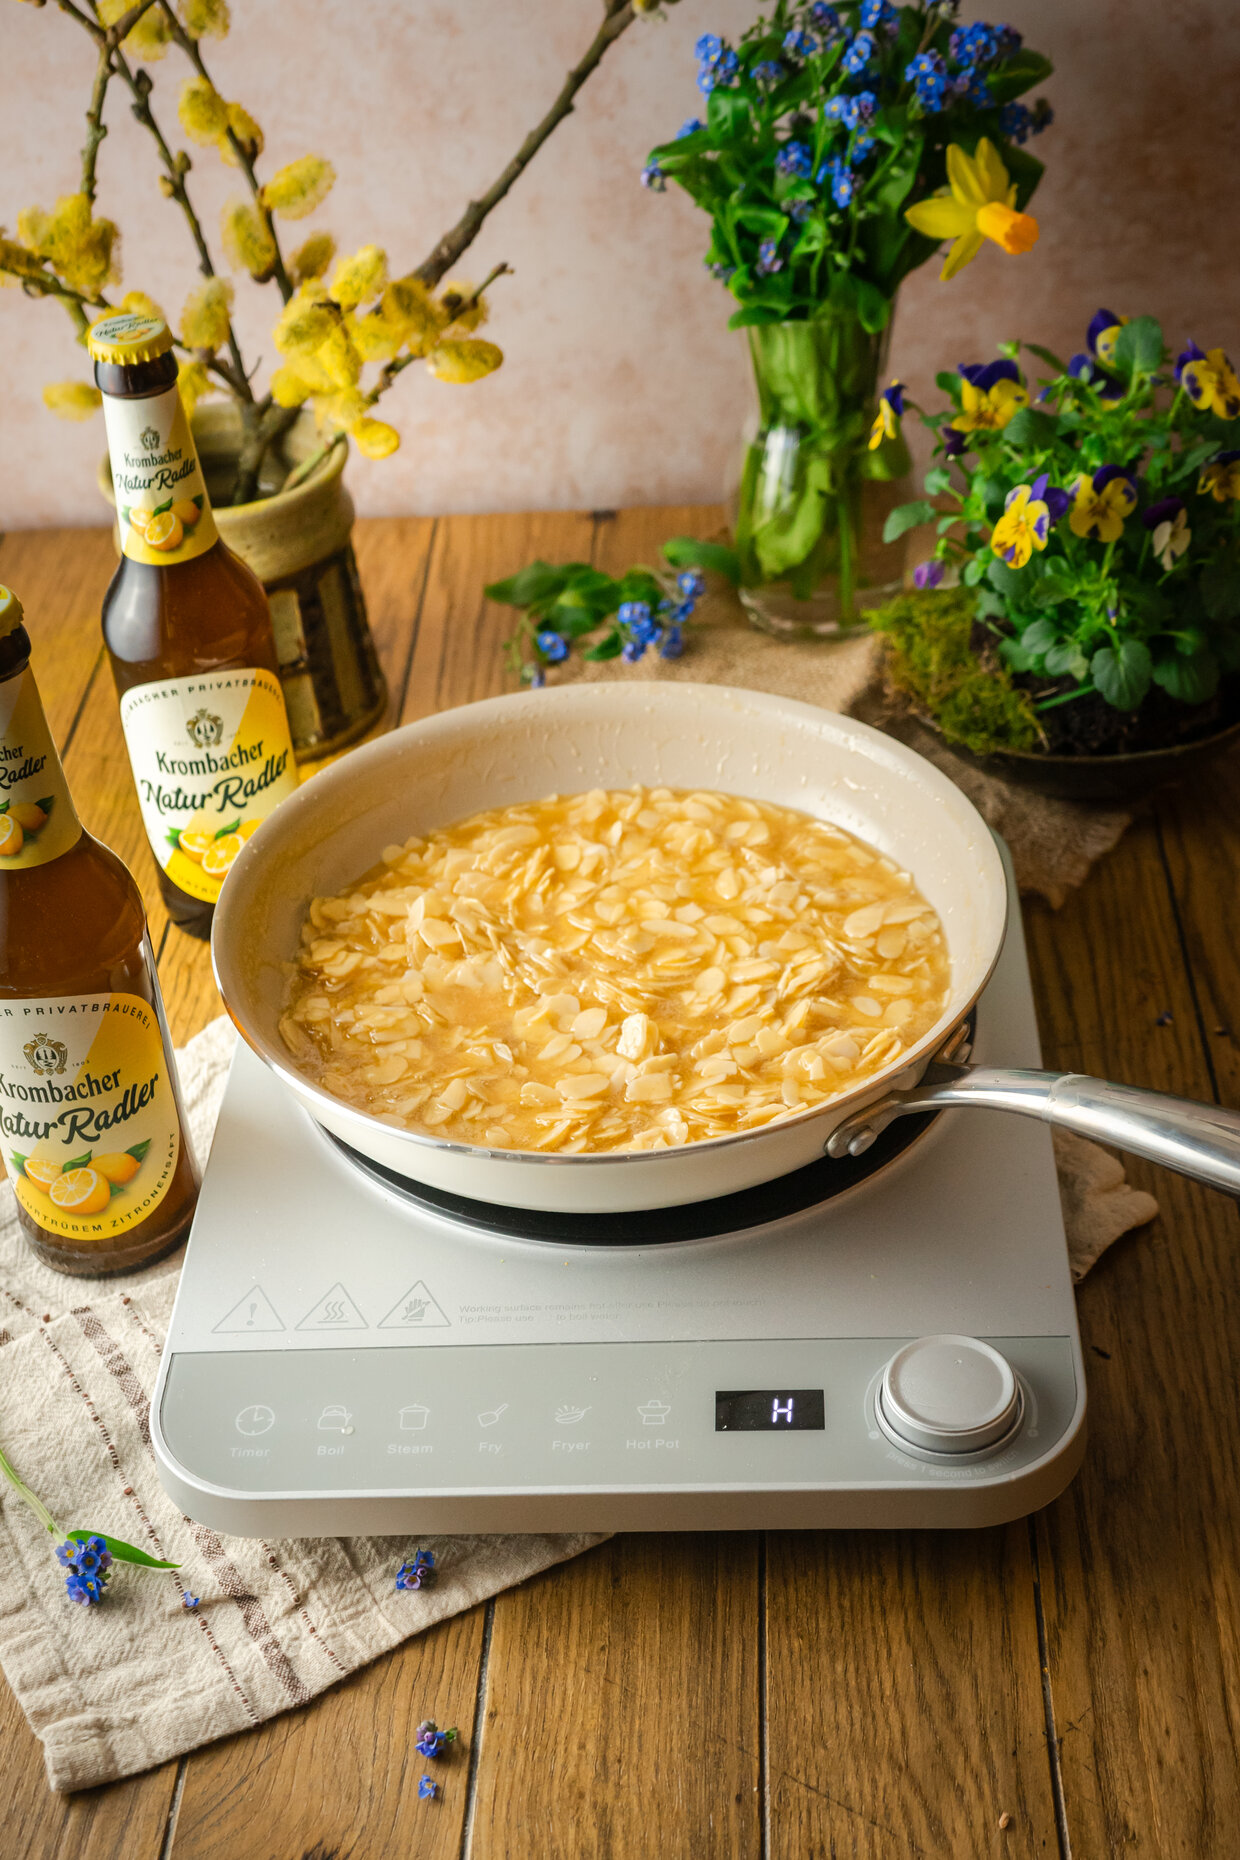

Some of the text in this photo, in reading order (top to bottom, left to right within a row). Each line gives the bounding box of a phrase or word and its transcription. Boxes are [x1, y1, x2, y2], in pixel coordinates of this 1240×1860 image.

[124, 448, 182, 468] Krombacher
[156, 741, 263, 775] Krombacher
[23, 1003, 150, 1030] PRIVATBRAUEREI
[459, 1305, 501, 1313] Working
[771, 1398, 793, 1423] H
[387, 1443, 433, 1455] Steam
[479, 1441, 503, 1454] Fry
[552, 1440, 591, 1453] Fryer
[626, 1438, 680, 1450] Hot Pot
[229, 1447, 271, 1458] Timer
[317, 1445, 345, 1456] Boil
[929, 1468, 972, 1478] second
[974, 1466, 985, 1475] to
